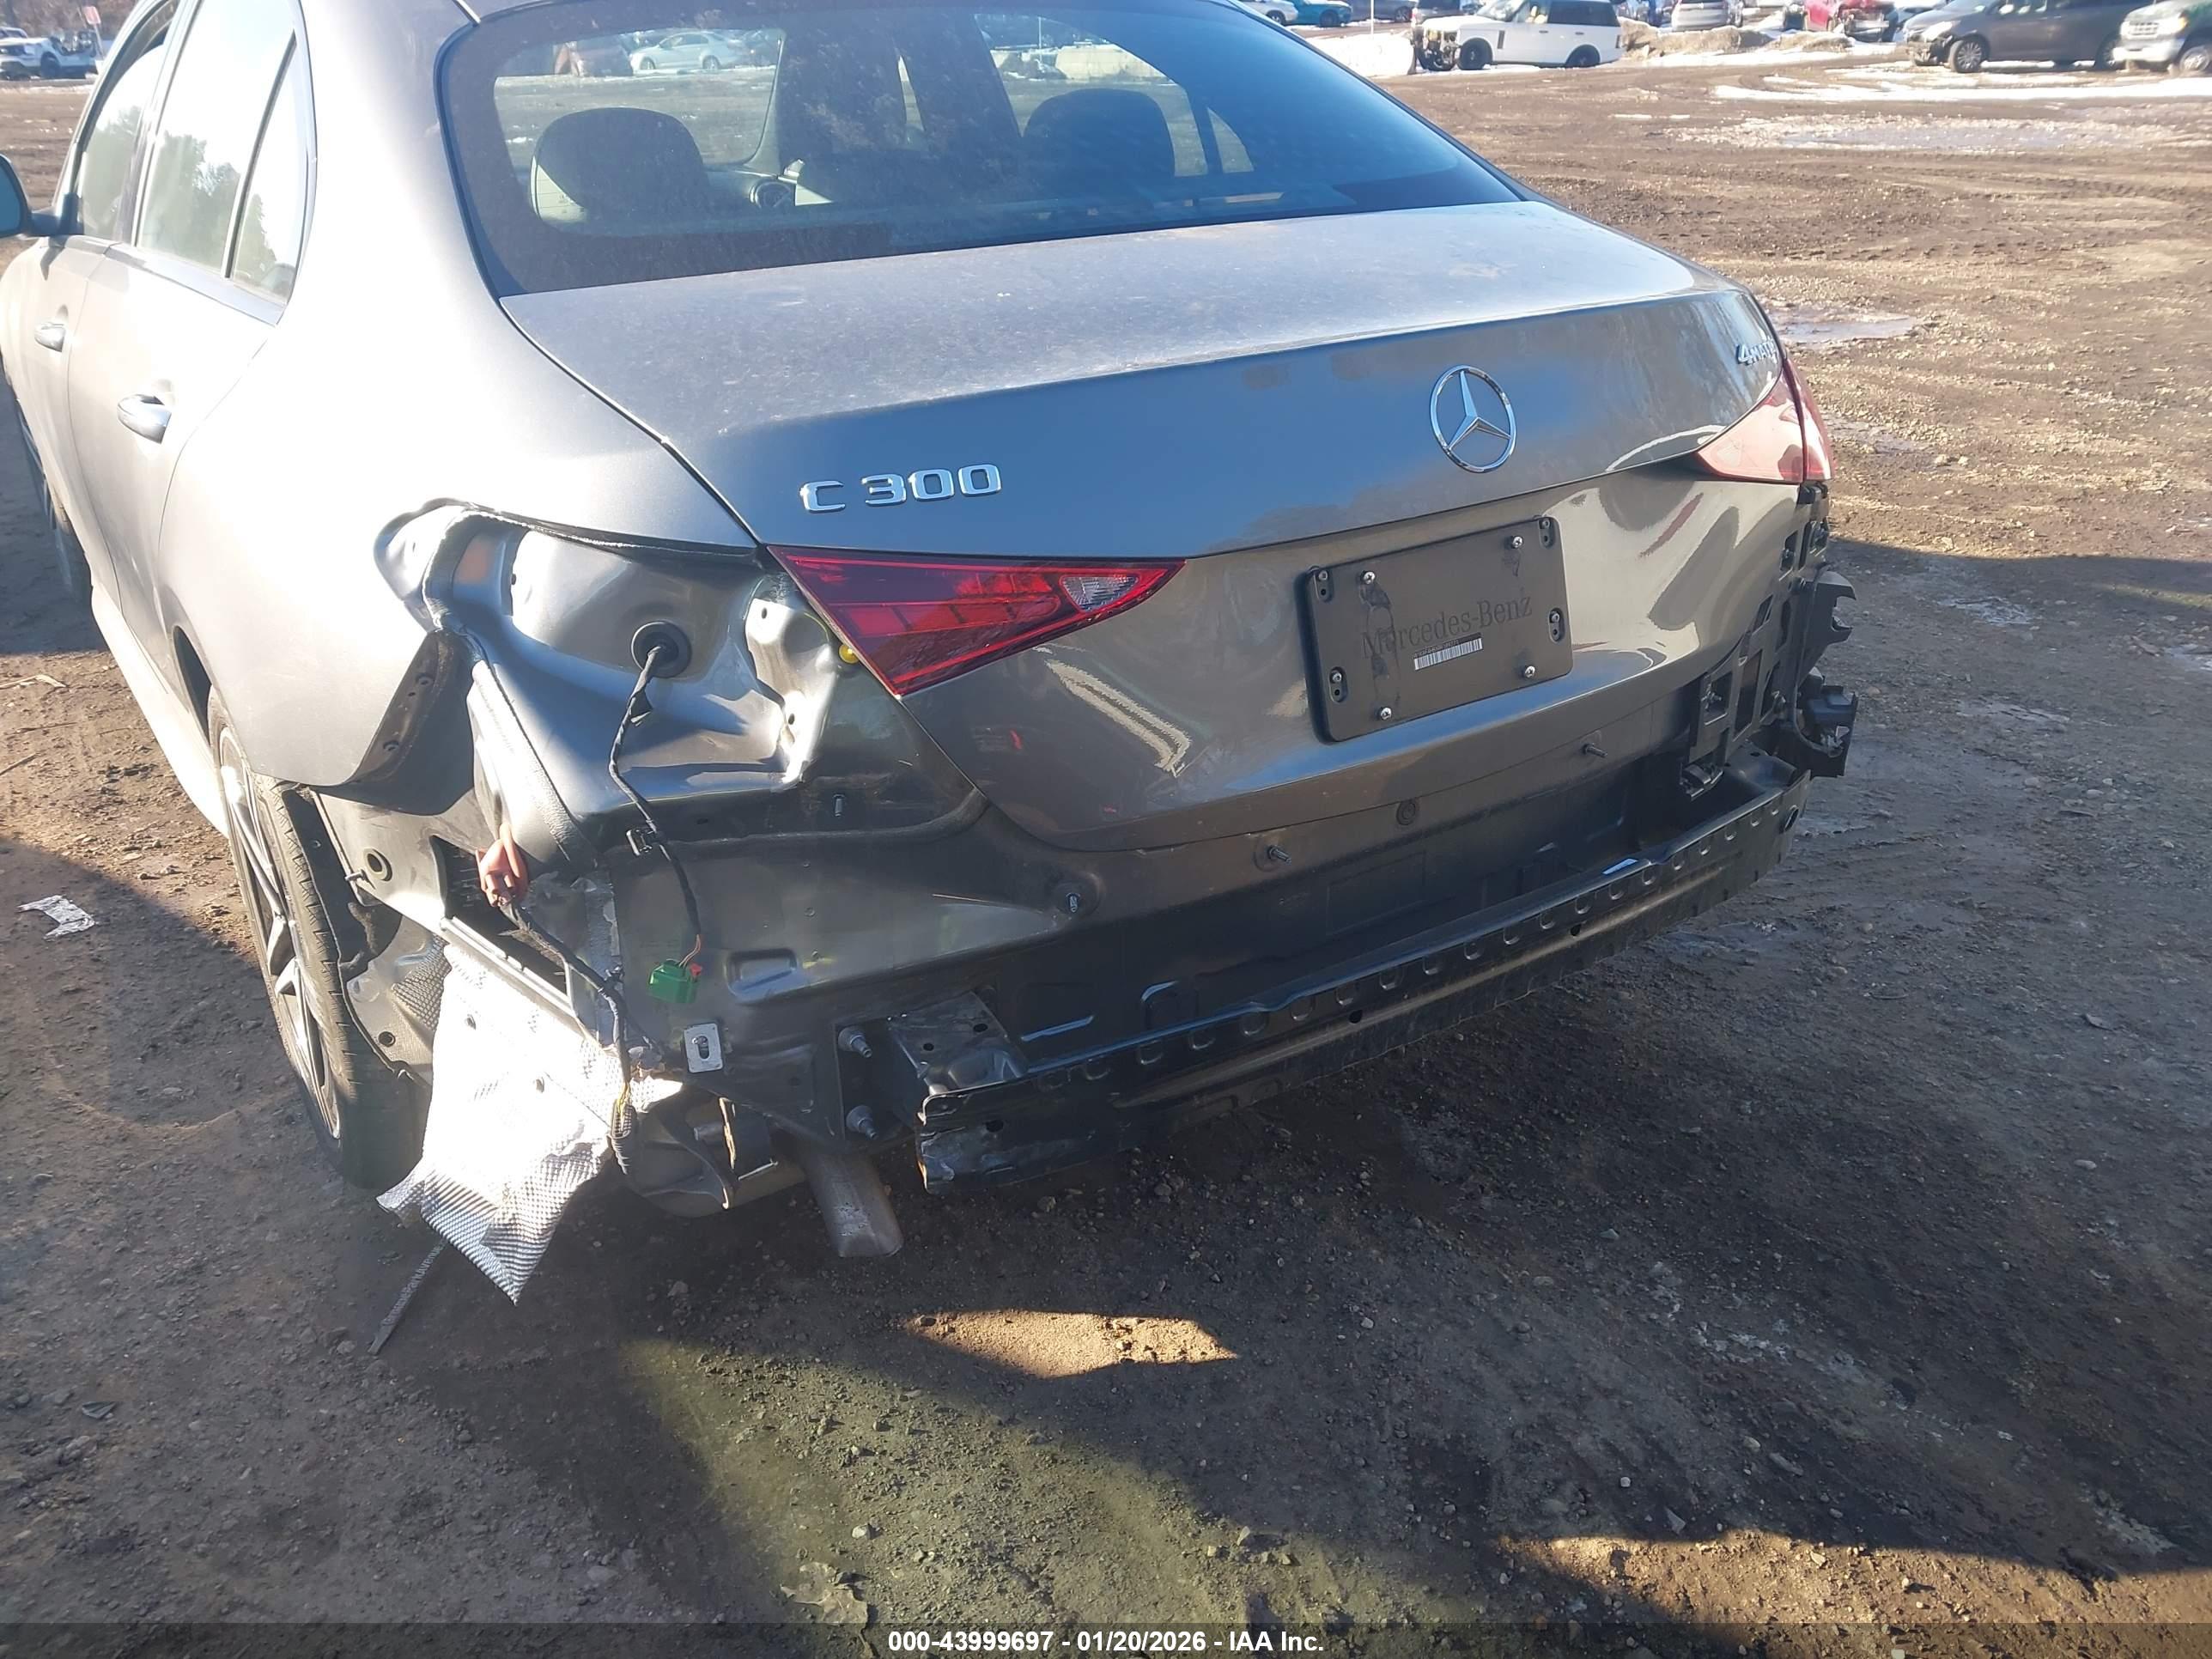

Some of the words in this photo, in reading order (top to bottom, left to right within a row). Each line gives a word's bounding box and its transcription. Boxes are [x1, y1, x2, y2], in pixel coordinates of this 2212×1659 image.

[799, 481, 845, 514] C
[861, 465, 1002, 507] 300
[1360, 596, 1532, 659] Mercedes-Benz
